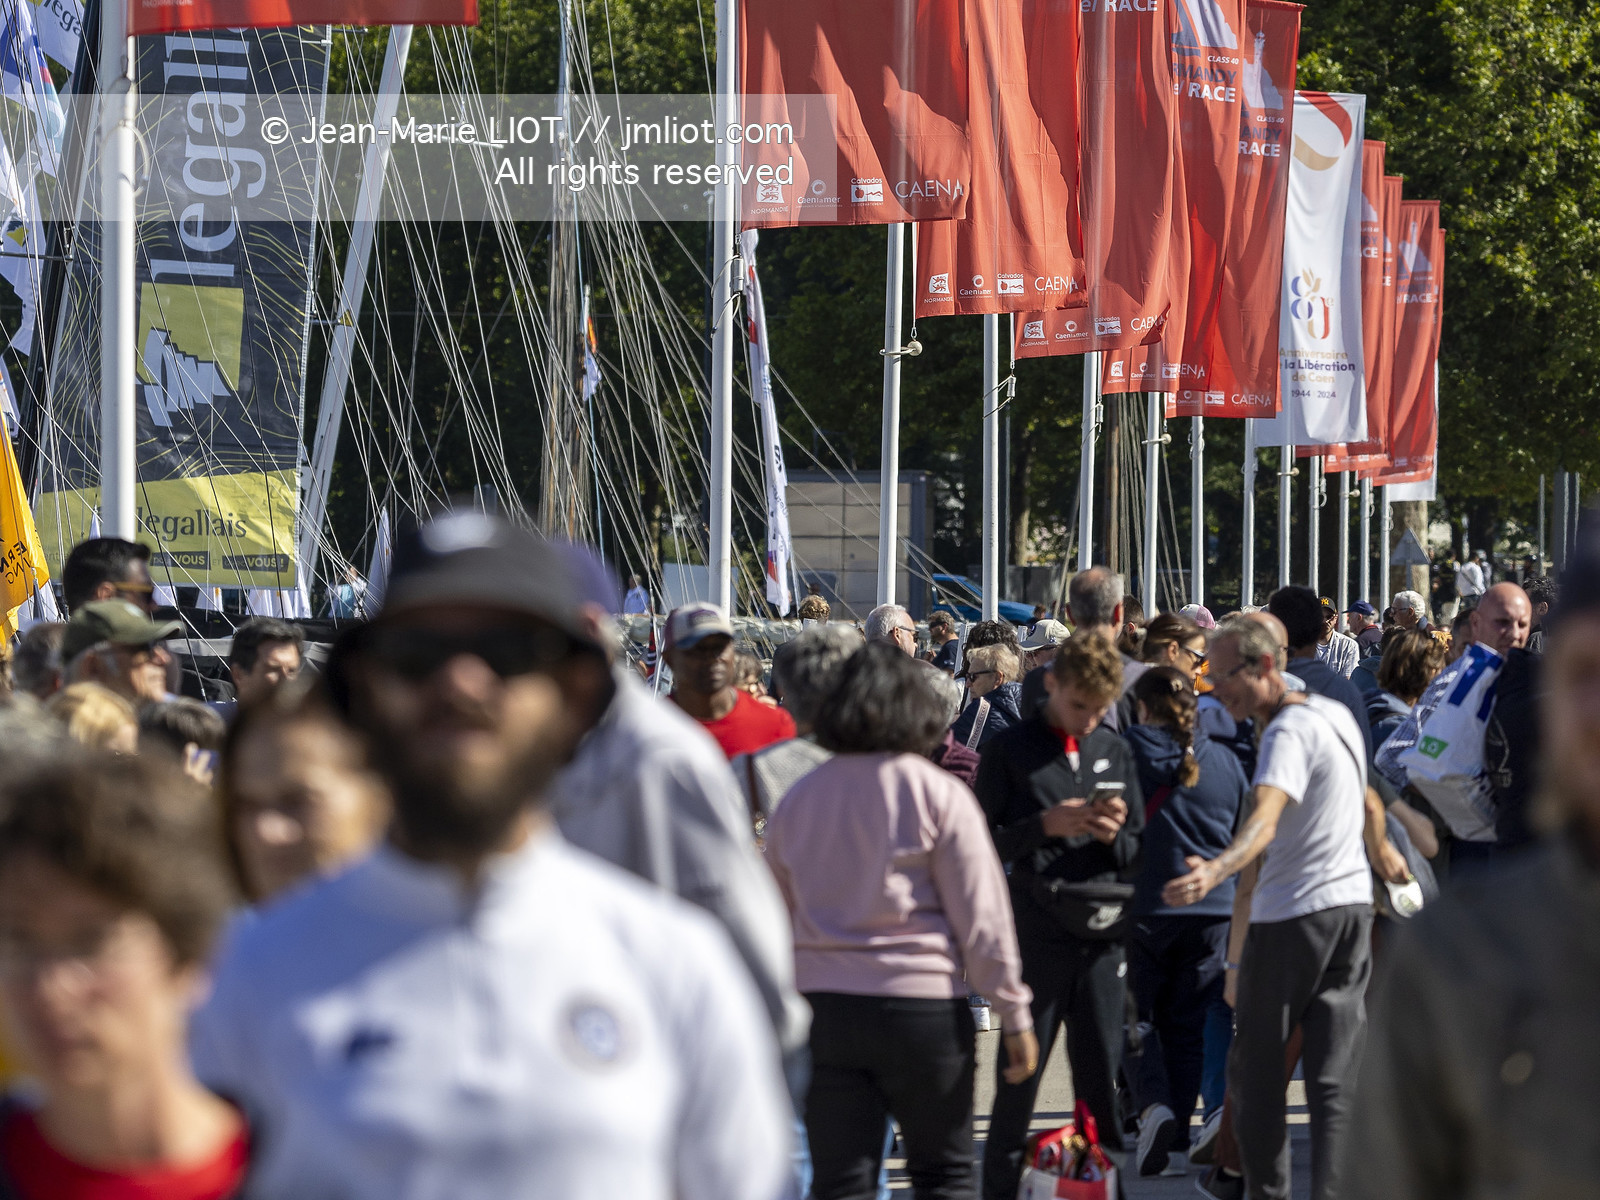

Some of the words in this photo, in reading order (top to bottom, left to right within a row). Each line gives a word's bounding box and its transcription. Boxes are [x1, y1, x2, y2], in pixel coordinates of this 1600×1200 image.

[1207, 55, 1229, 64] CLASS
[1230, 57, 1239, 65] 40
[1188, 82, 1236, 103] RACE
[1256, 115, 1275, 123] CLASS
[150, 27, 266, 283] legall
[1238, 141, 1280, 157] RACE
[851, 177, 882, 185] Calvados
[751, 205, 789, 215] NORMANDIE
[1403, 293, 1433, 304] RACE
[1280, 347, 1348, 360] Anniversaire
[1298, 359, 1356, 372] Libération
[1291, 371, 1306, 382] de
[1308, 371, 1335, 383] Caen
[1291, 389, 1311, 398] 1944
[1317, 389, 1337, 398] 2024
[137, 508, 247, 542] legallais
[173, 554, 205, 566] VOUS
[247, 556, 277, 568] VOUS
